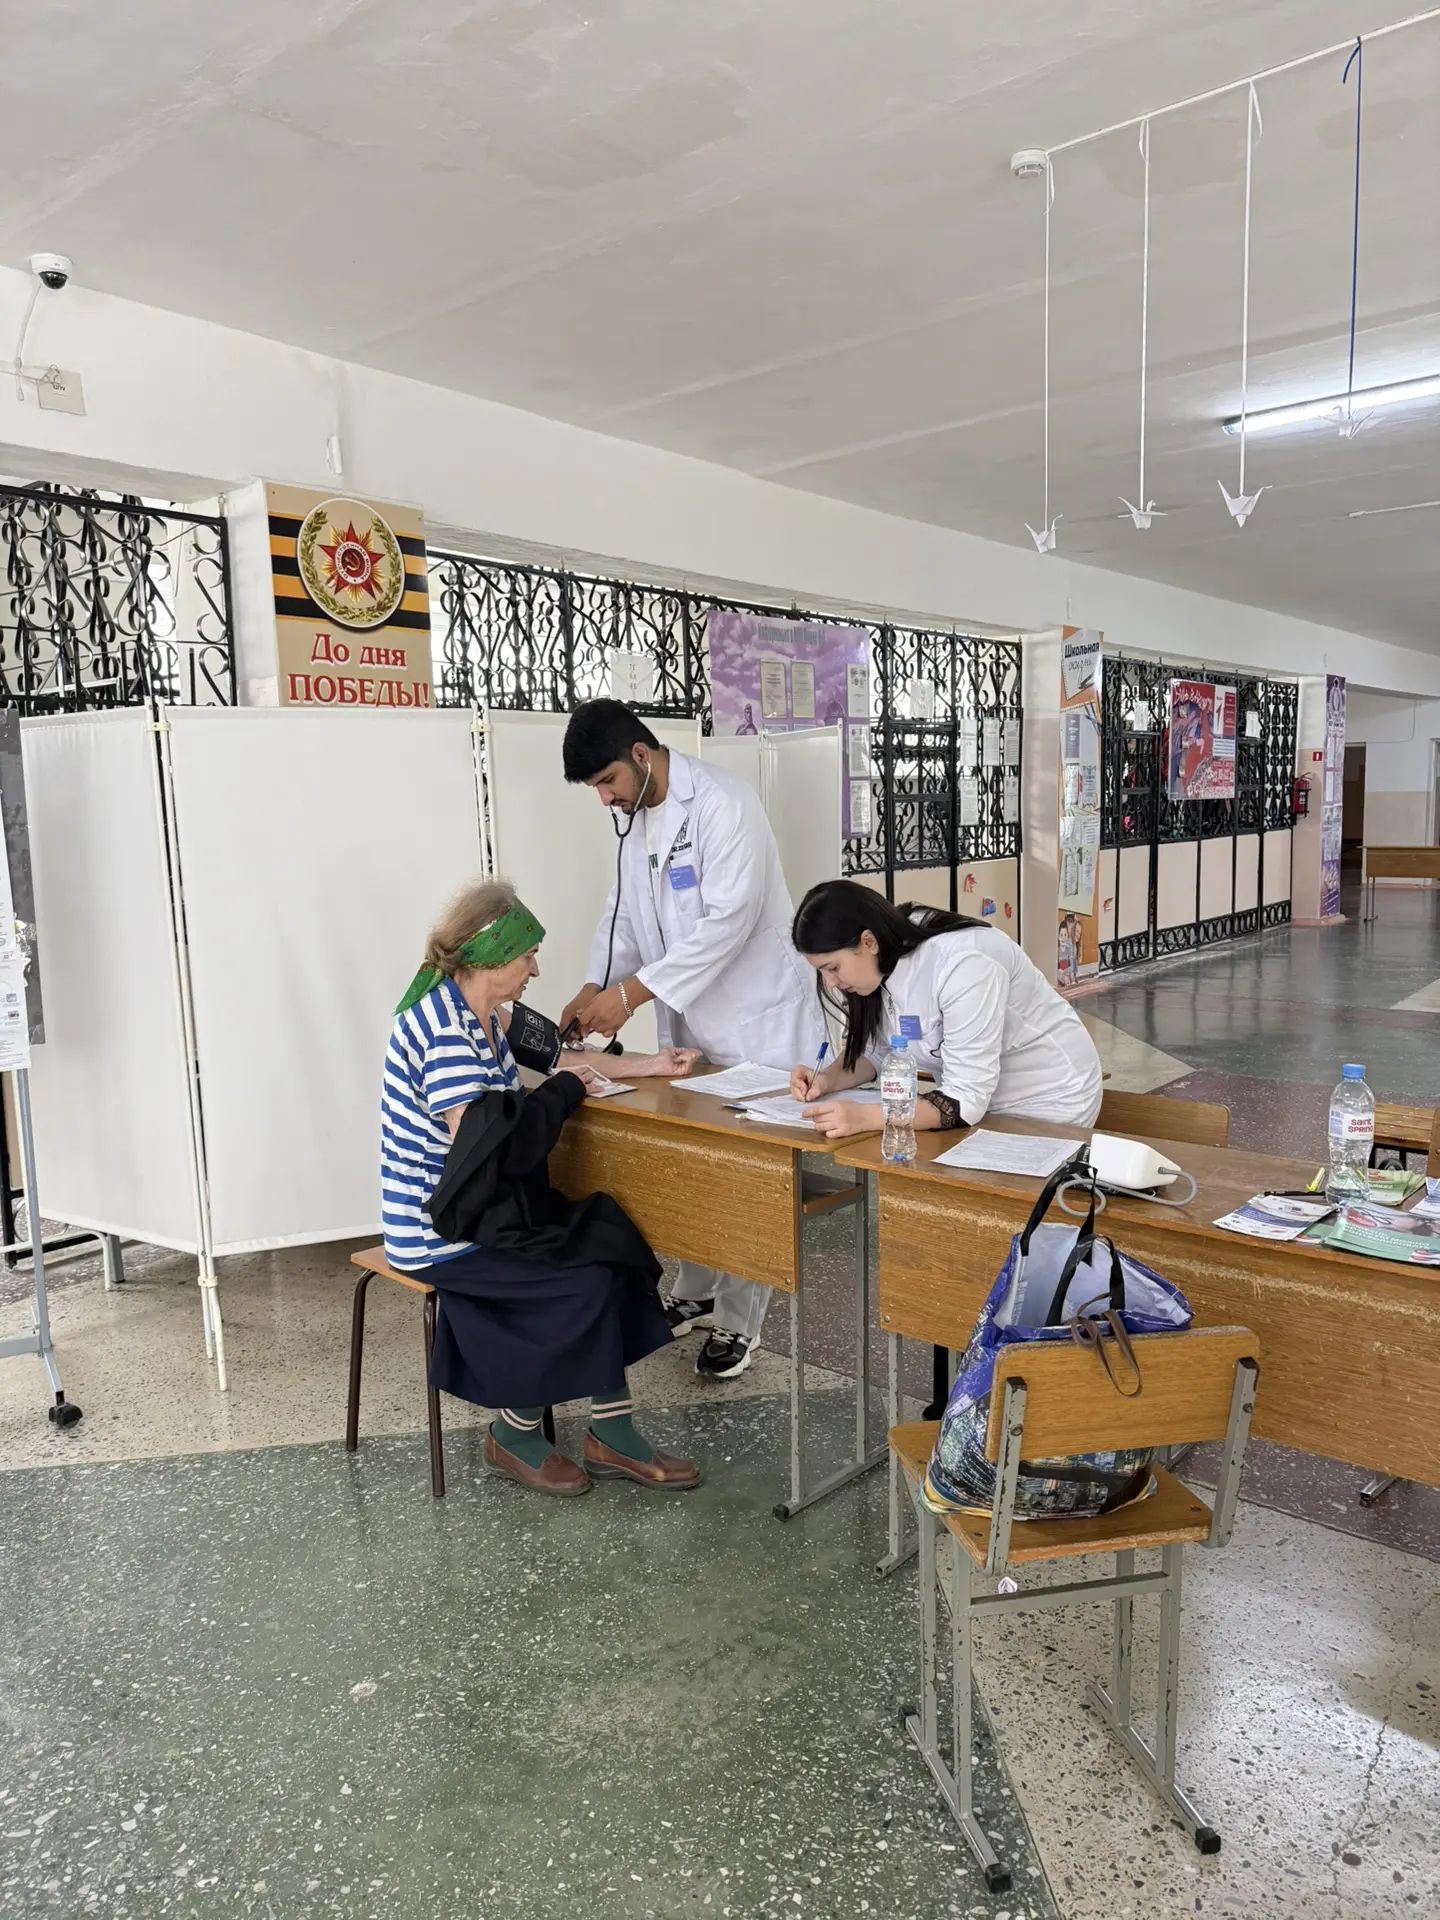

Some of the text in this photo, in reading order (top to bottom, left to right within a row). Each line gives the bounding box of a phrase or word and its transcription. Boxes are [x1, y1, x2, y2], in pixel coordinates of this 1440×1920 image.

[311, 633, 407, 669] До дня
[1064, 641, 1100, 659] Школьная
[288, 673, 430, 708] ПОБЕДЫ!
